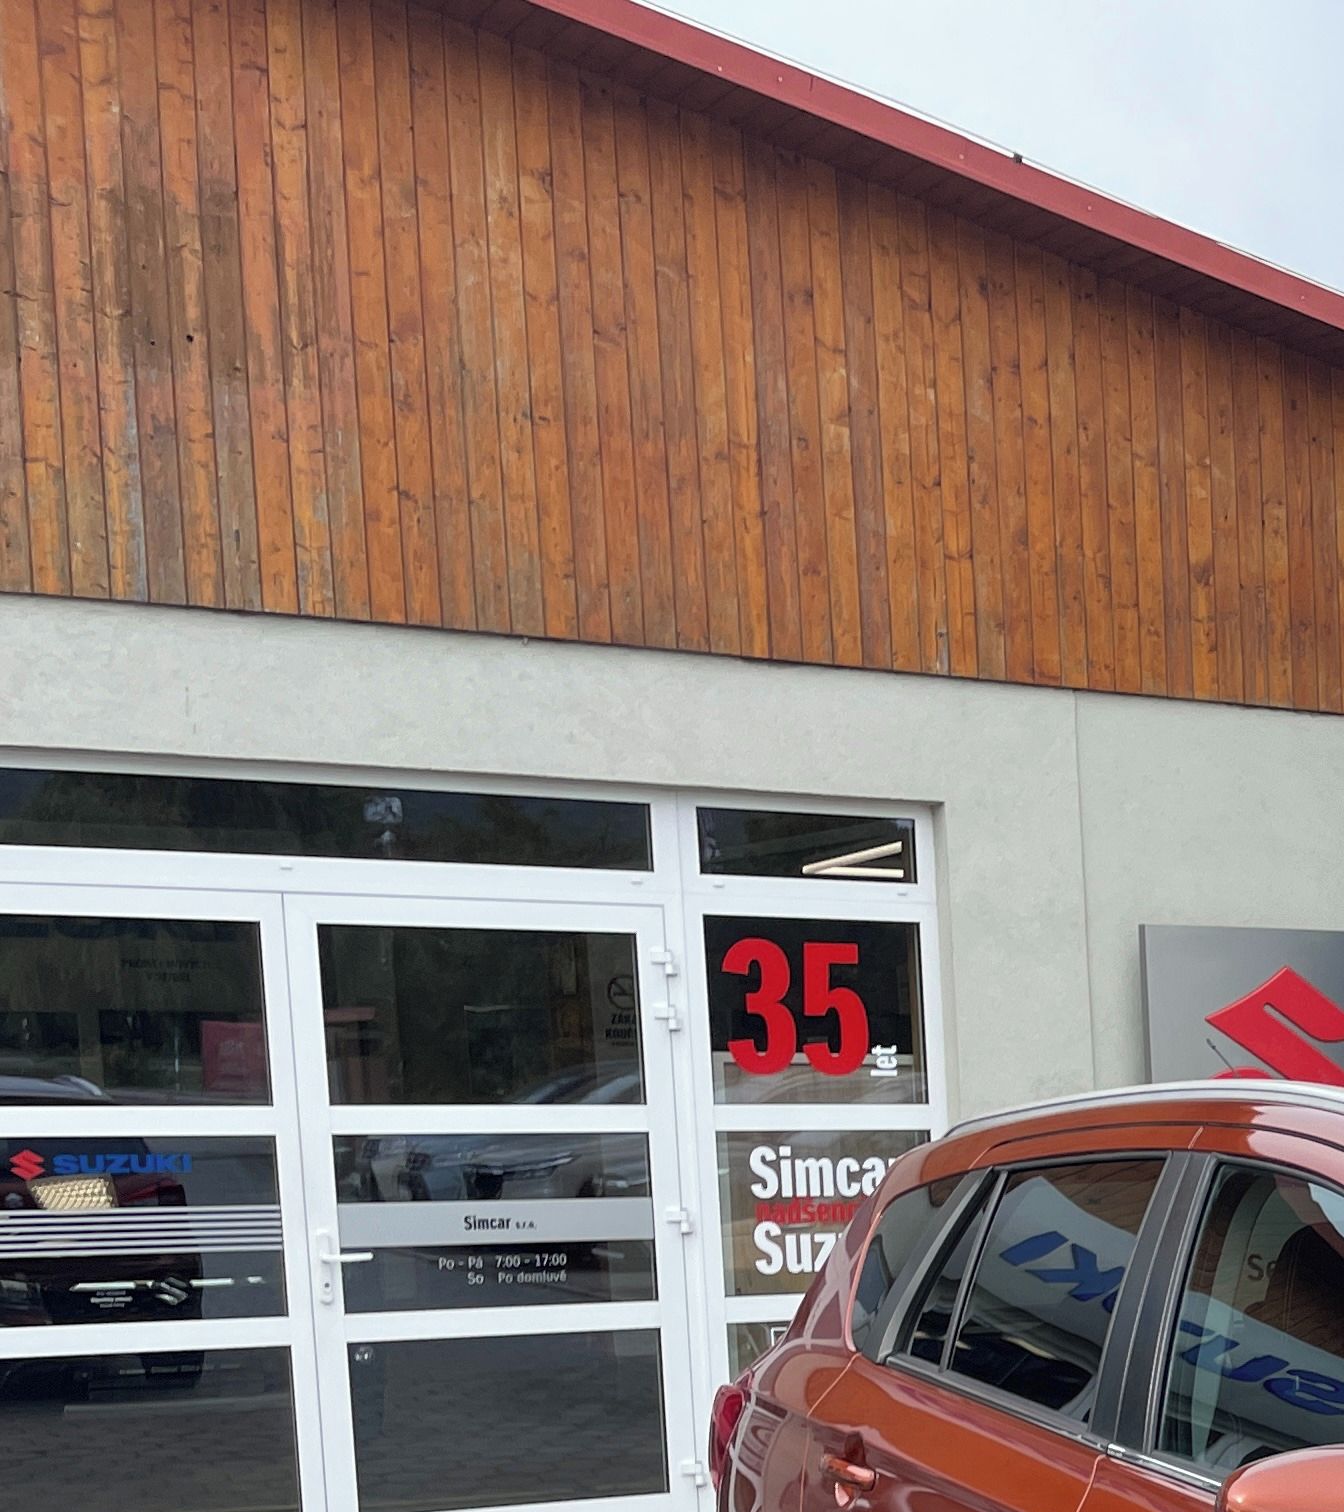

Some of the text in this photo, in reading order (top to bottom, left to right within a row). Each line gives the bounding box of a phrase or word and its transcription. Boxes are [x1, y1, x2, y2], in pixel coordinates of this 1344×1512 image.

[721, 937, 869, 1077] 35
[870, 1044, 898, 1077] let
[52, 1153, 192, 1174] SUZUKI
[749, 1145, 897, 1199] Simca
[464, 1215, 512, 1230] Simcar
[438, 1256, 455, 1270] Po
[468, 1254, 483, 1269] Pá
[495, 1255, 521, 1268] 7:00
[535, 1253, 567, 1267] 17:00
[753, 1220, 844, 1276] Suz
[467, 1269, 567, 1285] So Po domluvě
